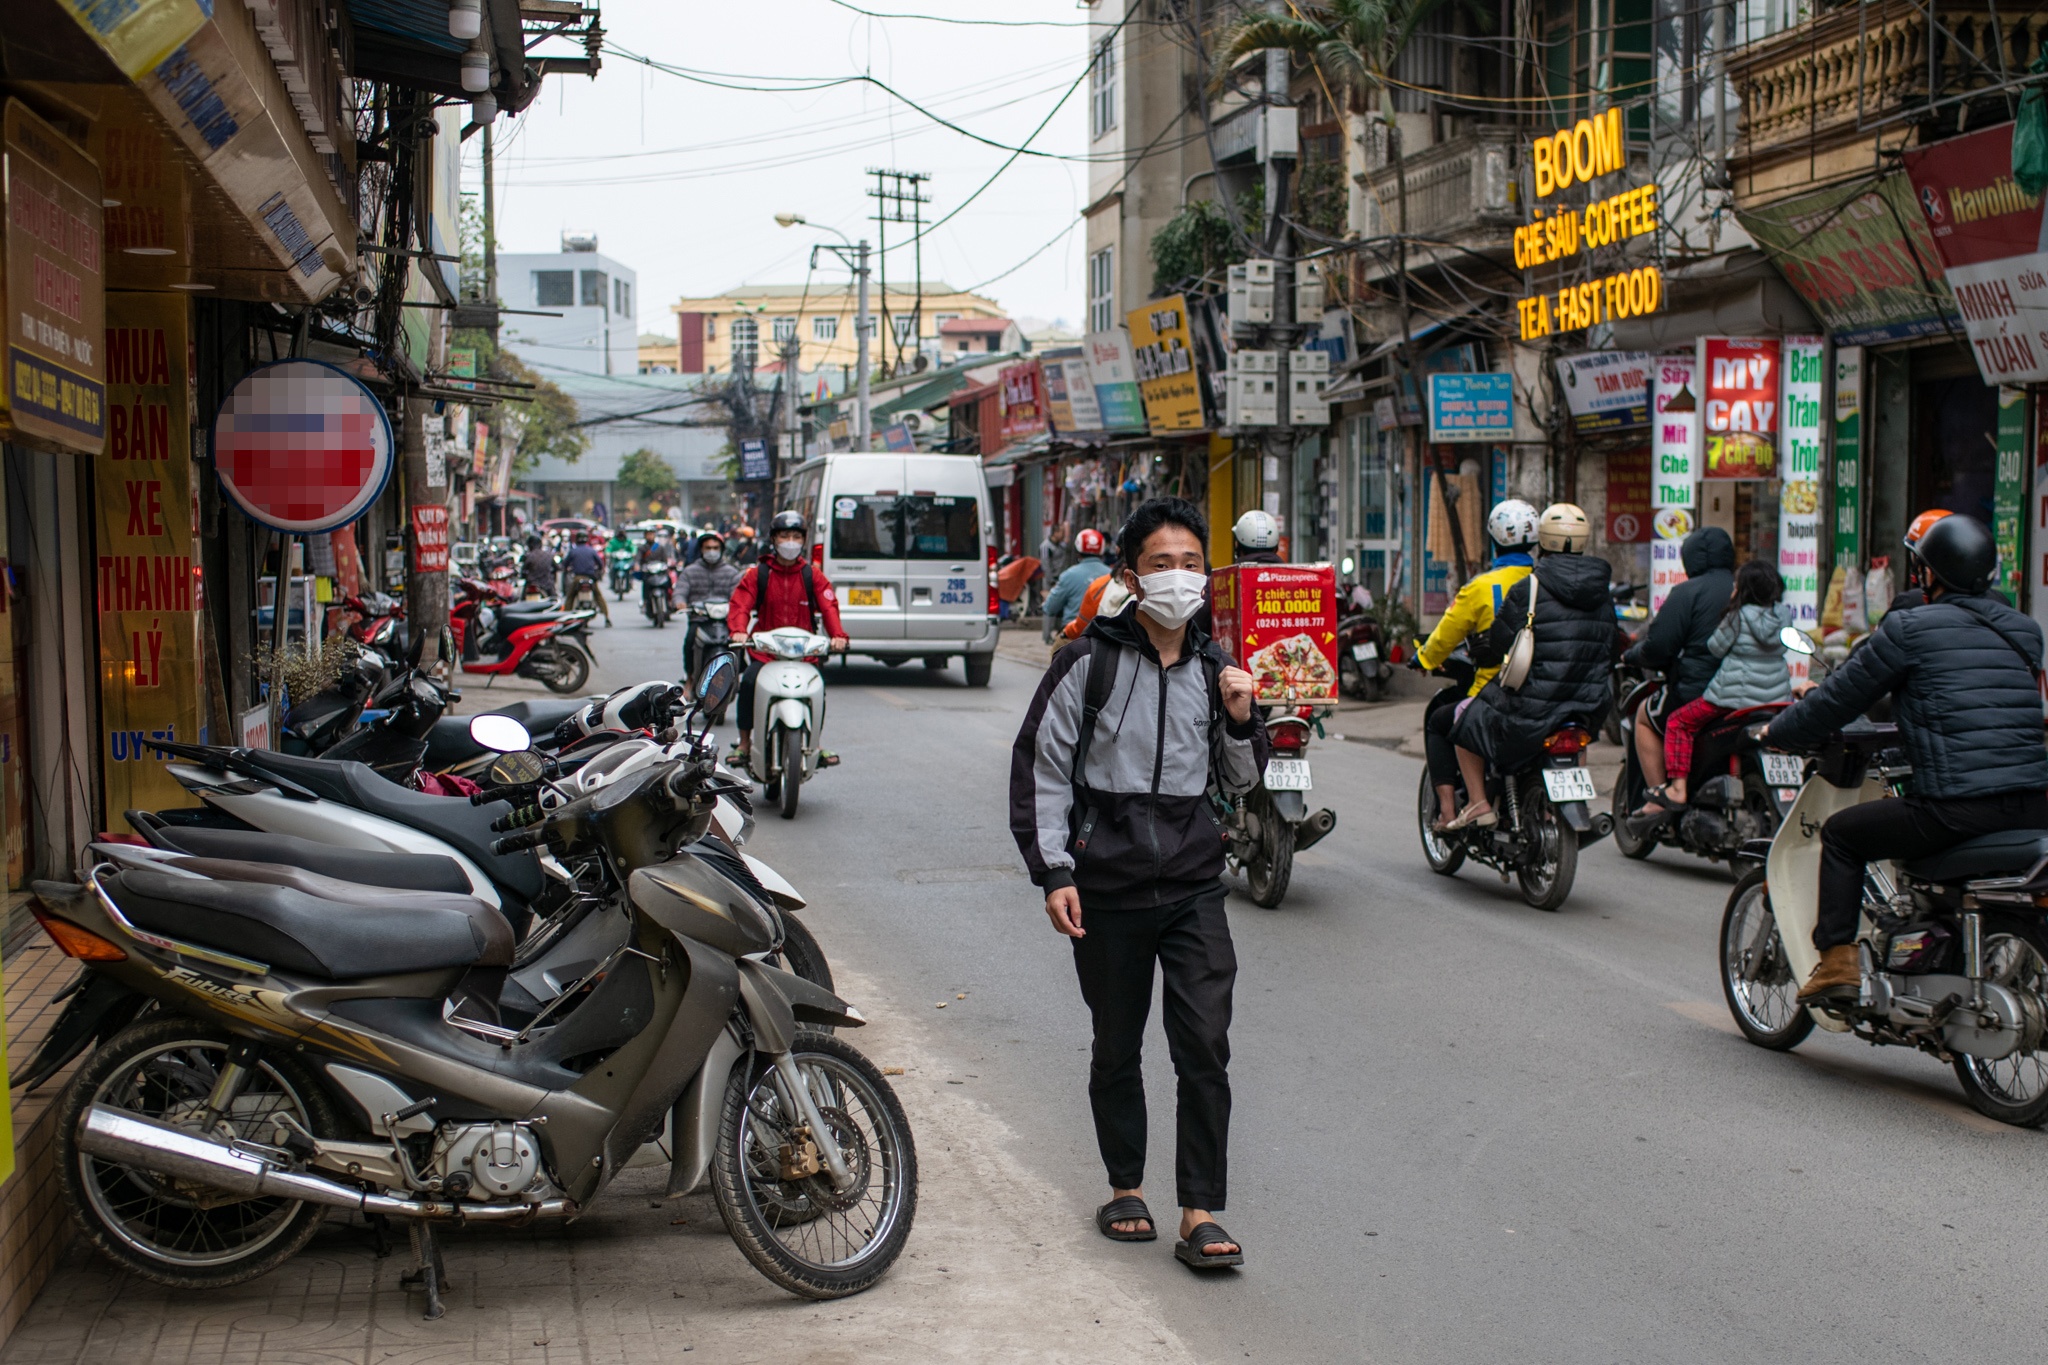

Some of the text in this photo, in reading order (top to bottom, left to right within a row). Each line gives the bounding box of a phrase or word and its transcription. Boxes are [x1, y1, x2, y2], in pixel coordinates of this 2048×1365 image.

[1534, 107, 1625, 198] BOOM
[1514, 208, 1547, 269] CHÈ
[33, 253, 81, 323] NHANH
[1517, 295, 1553, 341] TEA
[1606, 266, 1662, 323] FOOD
[1955, 278, 2018, 323] MINH
[105, 328, 170, 385] MUA
[1974, 320, 2039, 376] TUẤN
[1712, 353, 1771, 390] MỲ
[1705, 399, 1775, 431] CAY
[1788, 393, 1818, 427] Trán
[110, 395, 169, 461] BÁN
[1660, 452, 1689, 474] Chè
[1707, 435, 1725, 469] 7
[1838, 459, 1857, 494] GẠO
[1998, 451, 2020, 489] GẠO
[125, 480, 163, 536] XE
[1658, 484, 1690, 504] Thái
[100, 556, 191, 612] THANH
[940, 592, 974, 604] 204.25
[947, 579, 966, 590] 29B
[1256, 589, 1262, 600] 2
[1256, 617, 1325, 628] (024) 36.888.777
[1257, 600, 1321, 614] 140.000đ
[133, 618, 163, 687] LÝ
[111, 731, 144, 762] UY
[1769, 757, 1800, 769] 29-H1
[1268, 775, 1311, 788] 302.73
[1271, 761, 1304, 774] 88-B1
[1551, 784, 1593, 799] 671.79
